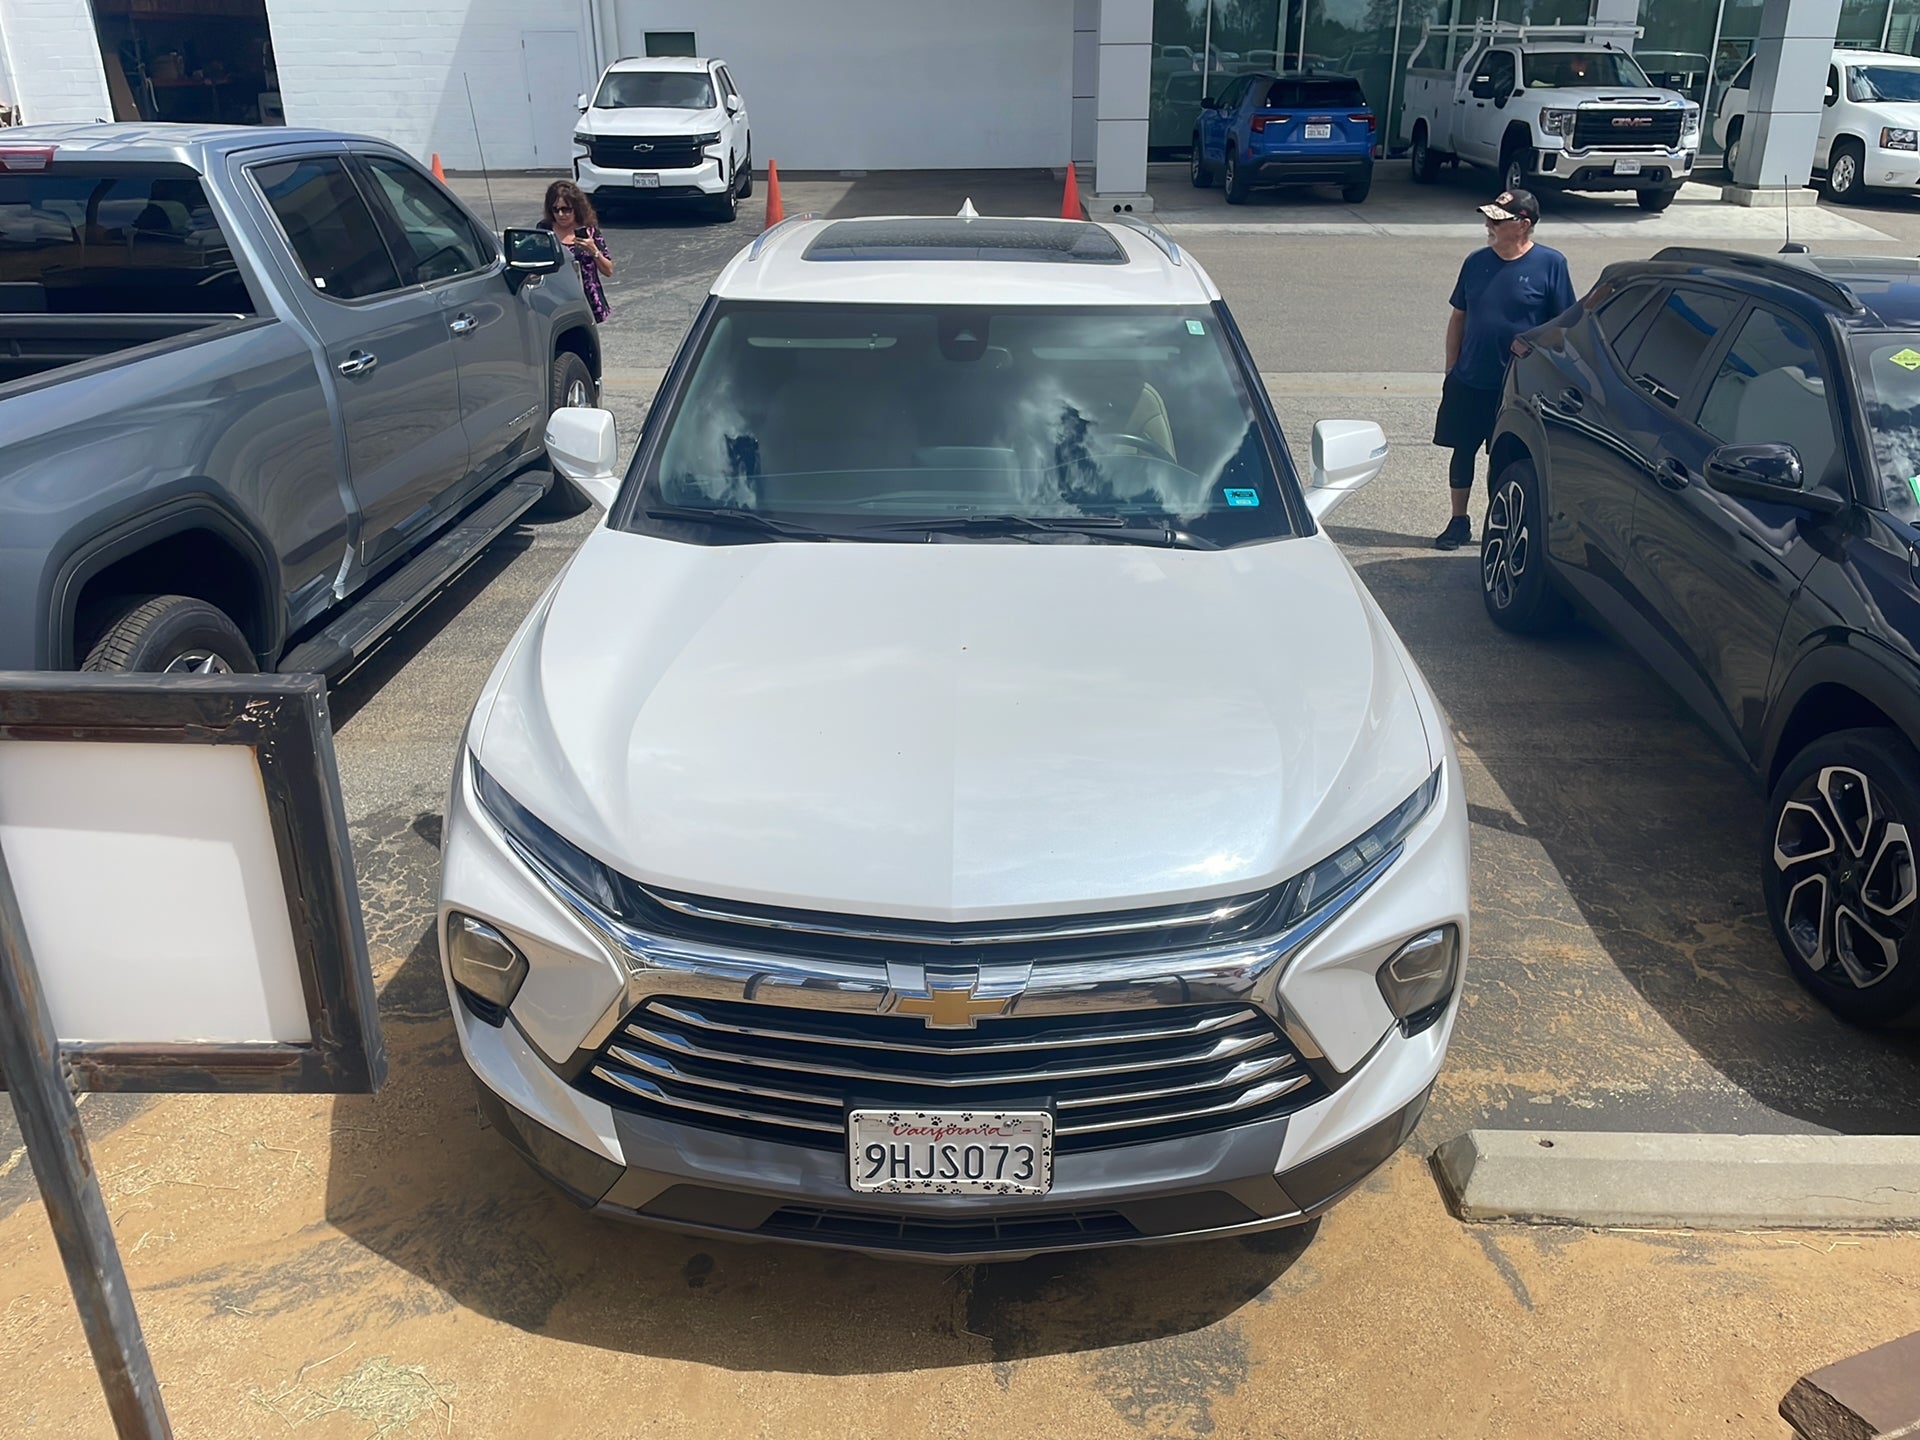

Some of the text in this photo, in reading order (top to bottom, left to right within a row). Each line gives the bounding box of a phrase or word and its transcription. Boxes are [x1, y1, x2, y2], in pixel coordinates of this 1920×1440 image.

[1611, 117, 1652, 127] GMC
[893, 1124, 1013, 1142] California
[865, 1143, 1034, 1180] 9HJS073
